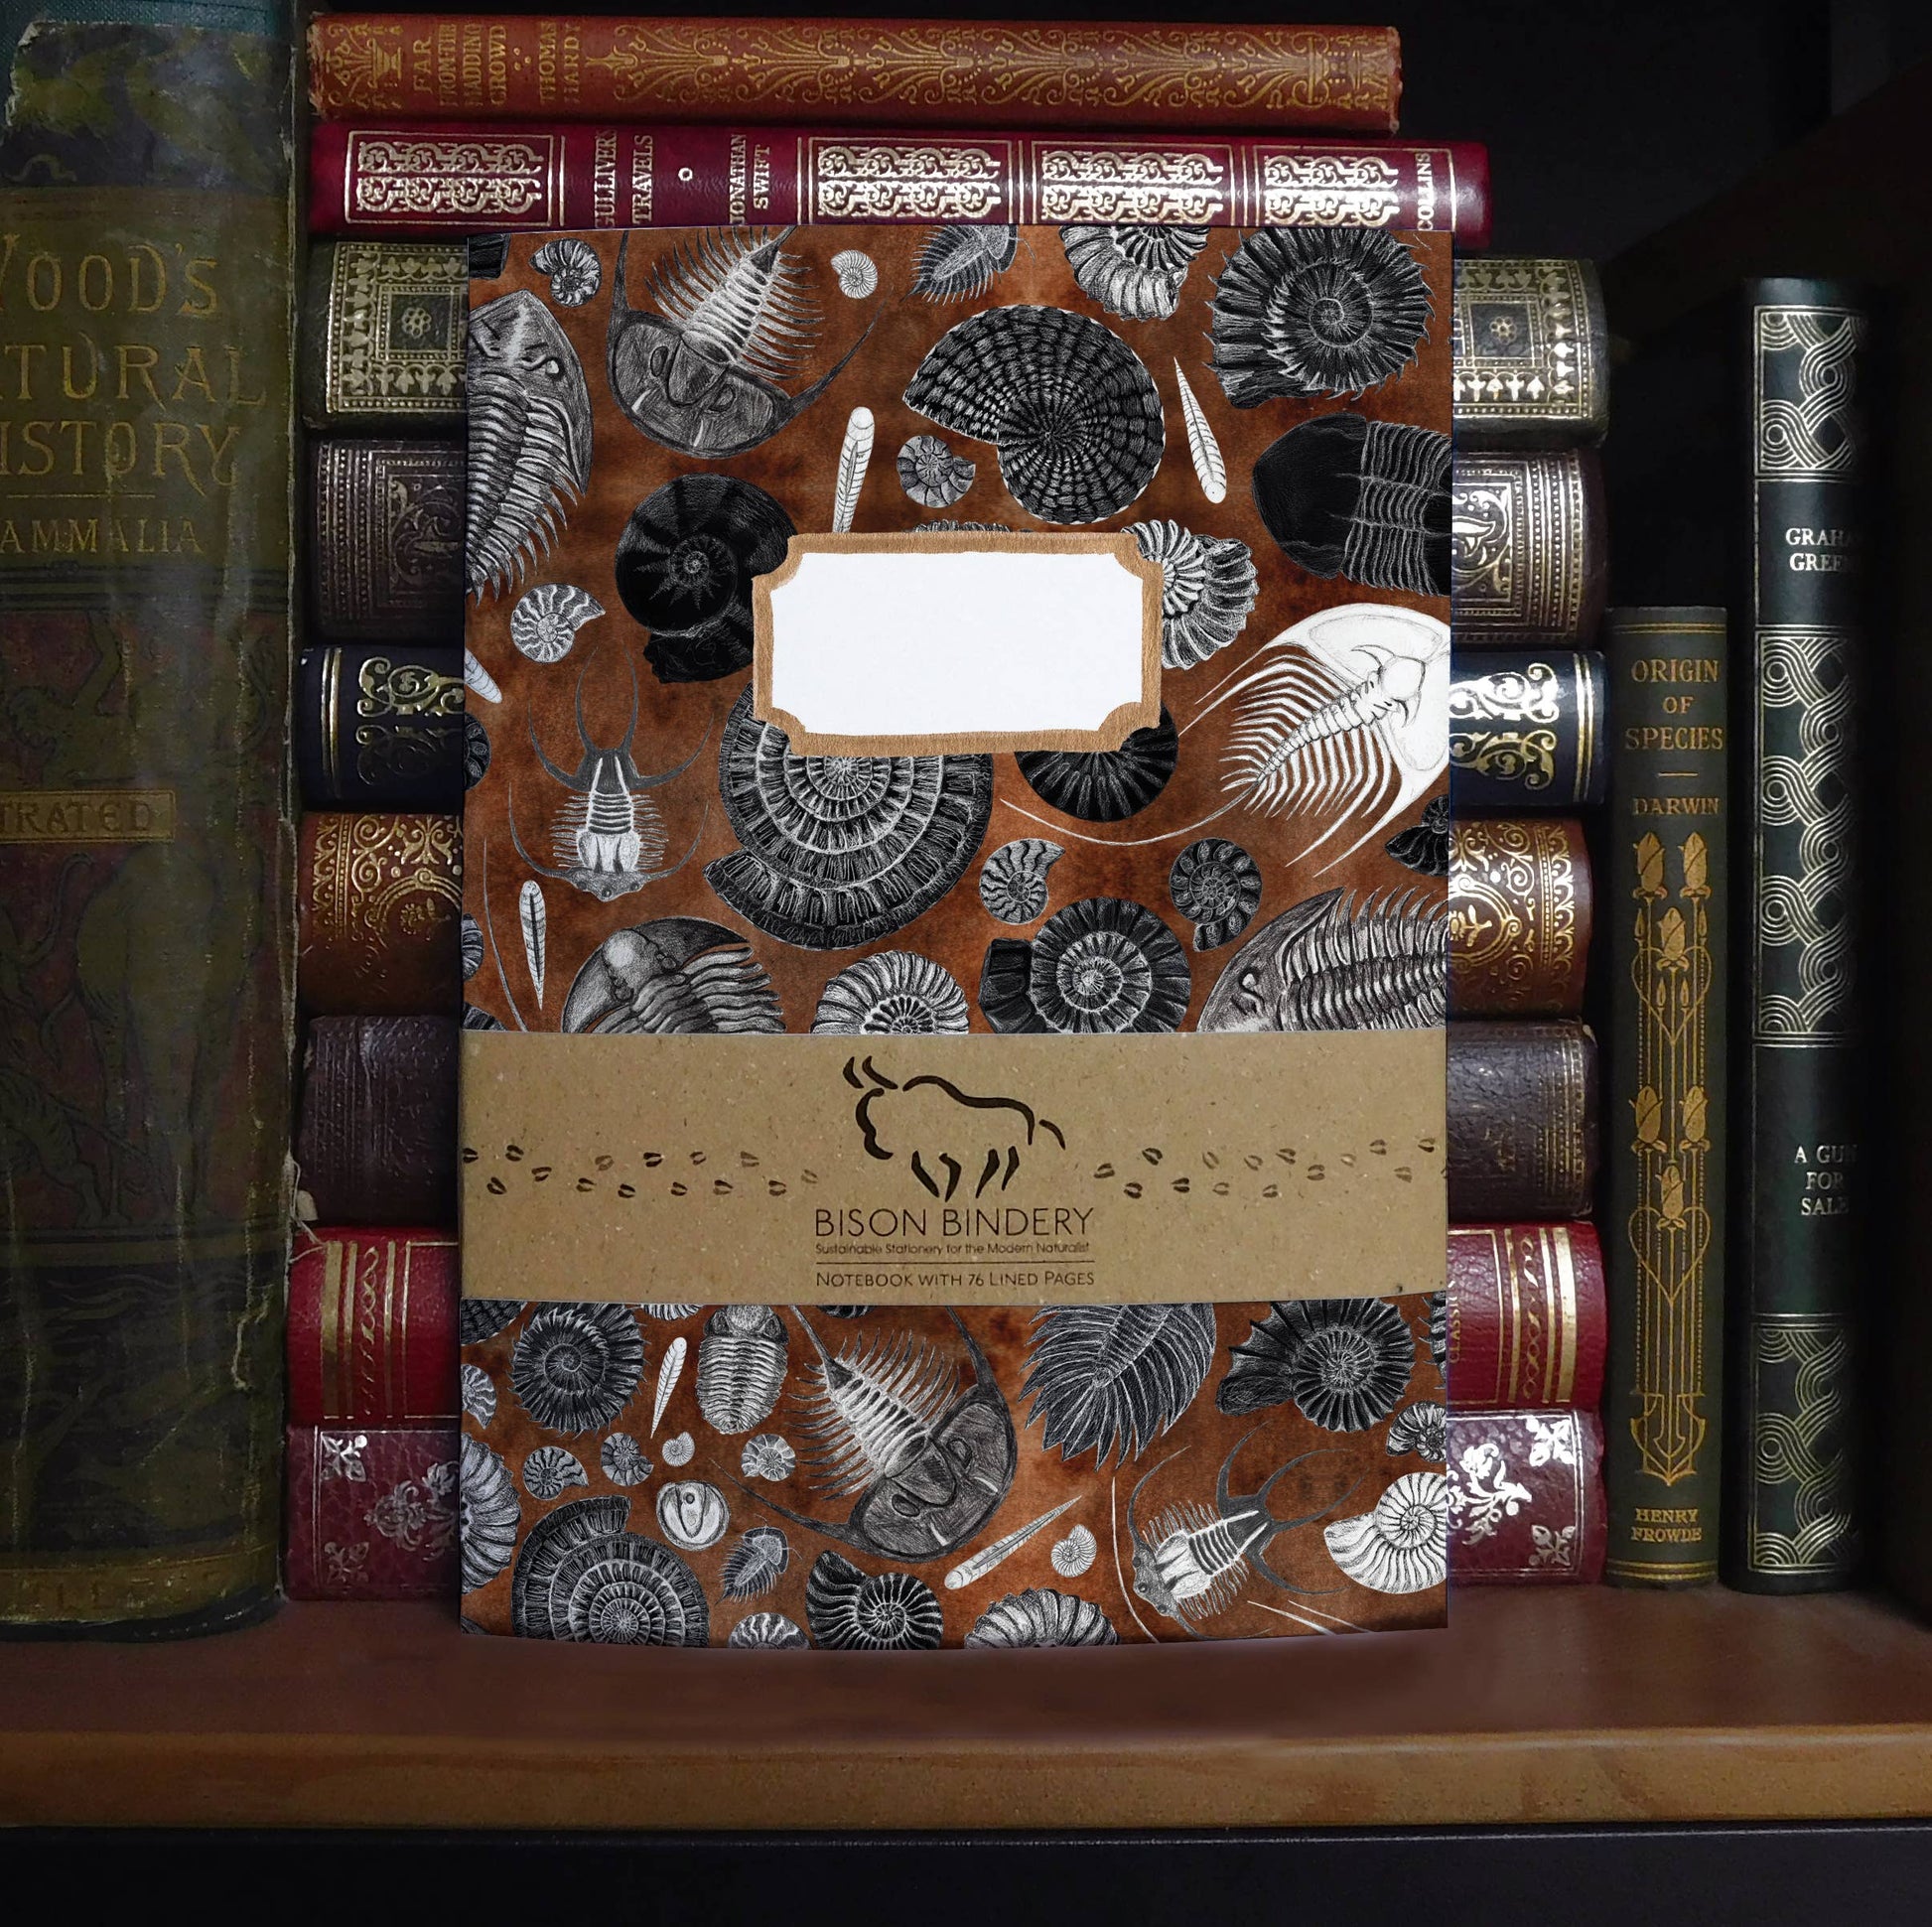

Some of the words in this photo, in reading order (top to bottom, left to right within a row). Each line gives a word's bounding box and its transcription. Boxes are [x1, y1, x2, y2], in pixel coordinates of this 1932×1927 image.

[413, 37, 432, 93] FAR
[488, 24, 506, 105] CROWD
[539, 21, 557, 103] THOMAS
[564, 22, 581, 103] HARDY
[632, 134, 653, 224] TRAVELS
[729, 134, 747, 226] JONATHAN
[753, 144, 770, 209] SWIFT
[1415, 151, 1435, 231] COLLINS
[0, 332, 266, 411] TURAL
[1631, 658, 1720, 684] ORIGIN
[1662, 696, 1695, 714] OF
[1625, 727, 1724, 751] SPECIES
[1632, 797, 1720, 815] DARWIN
[1794, 1145, 1808, 1164] A
[815, 1208, 926, 1237] BISON
[943, 1207, 1094, 1236] BINDERY
[816, 1243, 883, 1255] Sustainable
[886, 1243, 943, 1256] Stationery
[946, 1243, 963, 1254] for
[965, 1243, 984, 1254] the
[988, 1243, 1033, 1254] Modern
[1035, 1242, 1090, 1254] Naturalist
[918, 1273, 962, 1287] WITH
[968, 1273, 984, 1287] 76
[1634, 1507, 1699, 1524] HENRY
